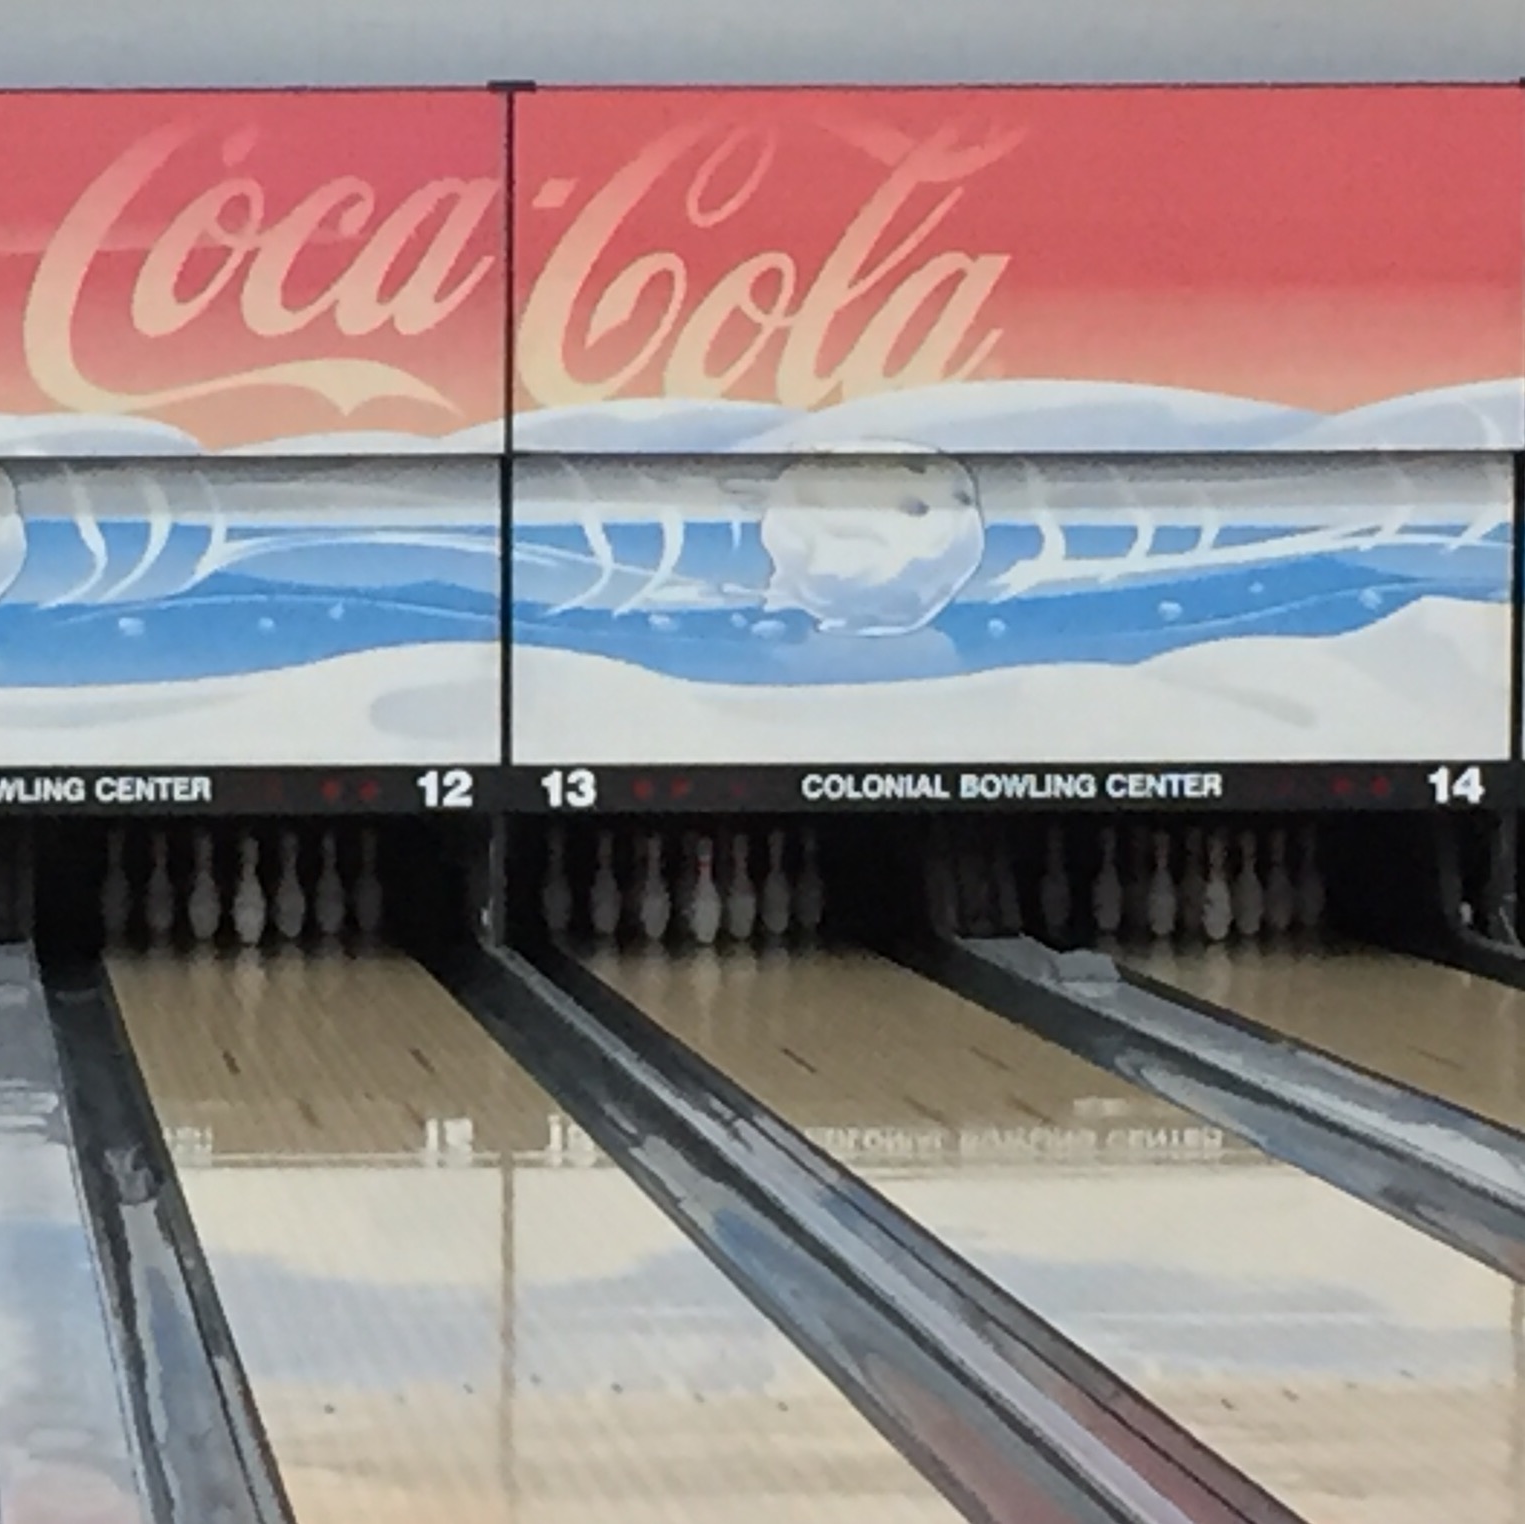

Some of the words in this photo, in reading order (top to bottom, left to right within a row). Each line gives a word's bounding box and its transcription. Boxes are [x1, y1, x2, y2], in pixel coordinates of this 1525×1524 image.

[95, 776, 211, 802] CENTER
[417, 771, 473, 807] 12
[541, 770, 597, 807] 13
[802, 774, 950, 800] COLONIAL
[960, 773, 1097, 799] BOWLING
[1106, 773, 1222, 798] CENTER
[1429, 768, 1485, 804] 14
